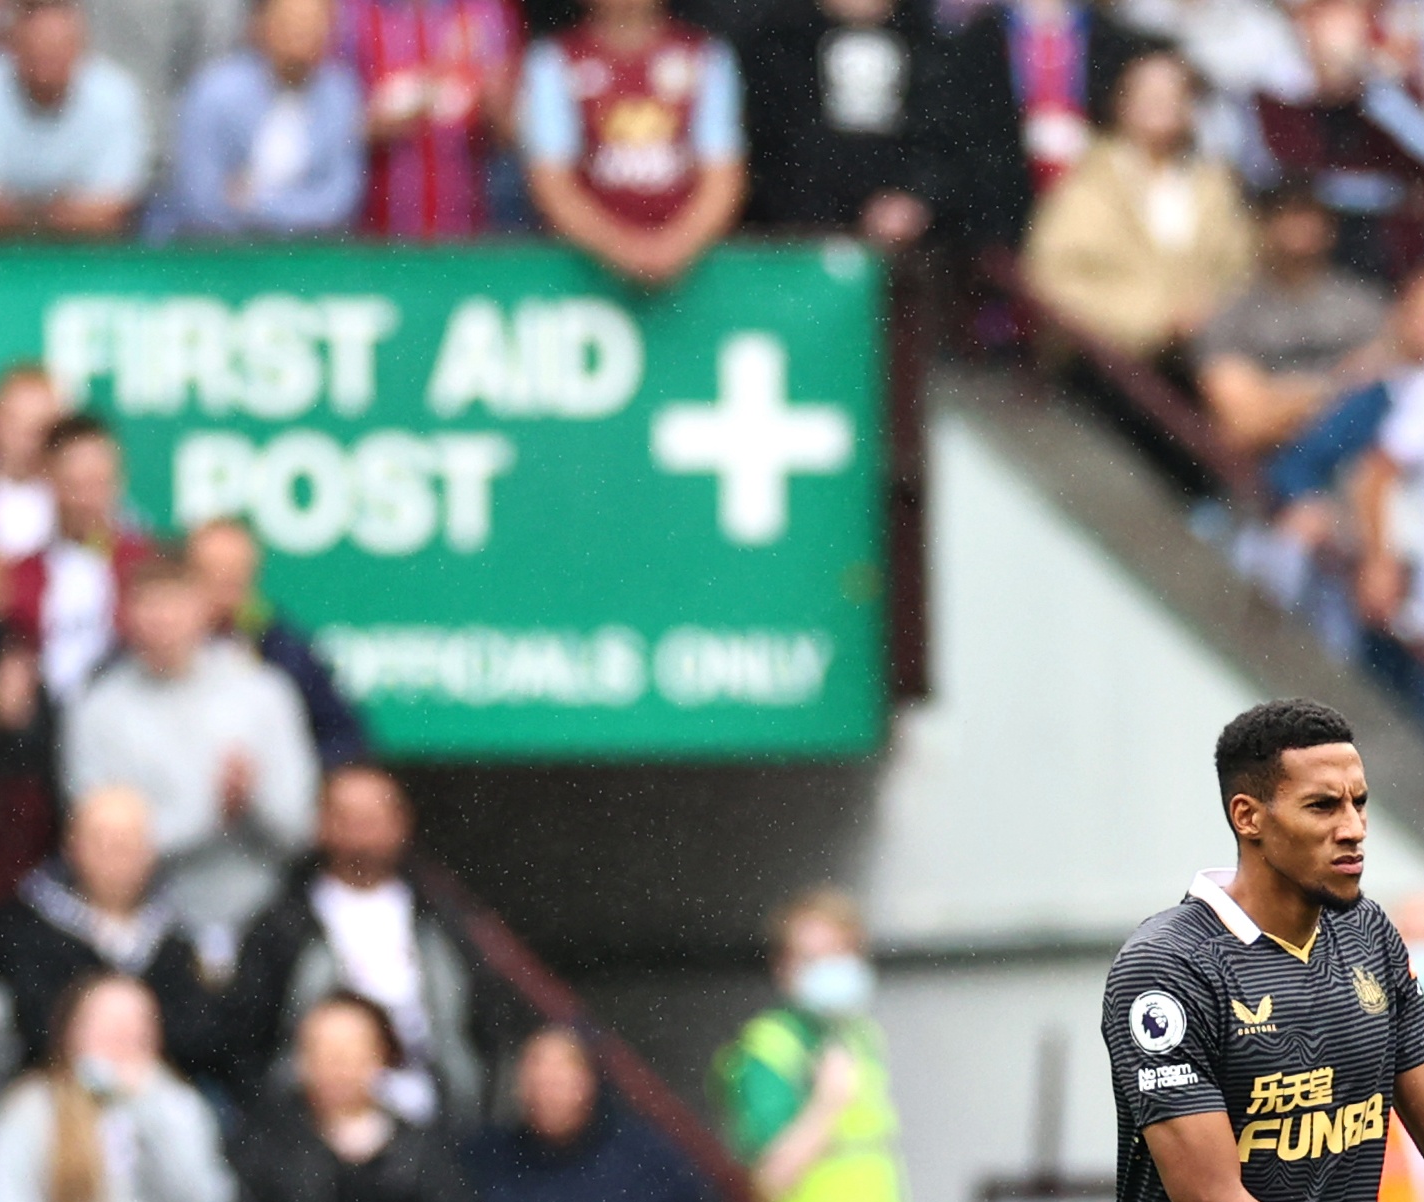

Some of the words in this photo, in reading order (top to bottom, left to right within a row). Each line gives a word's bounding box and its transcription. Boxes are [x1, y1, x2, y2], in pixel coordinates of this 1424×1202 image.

[43, 296, 397, 418] FIRST
[425, 296, 644, 420] AID
[175, 430, 515, 555] POST
[655, 624, 832, 705] ONLY
[1138, 1068, 1156, 1080] No
[1156, 1063, 1191, 1077] room
[1139, 1079, 1156, 1092] for
[1157, 1072, 1199, 1088] racism
[1246, 1066, 1334, 1115] 乐天堂
[1239, 1093, 1384, 1163] FUN88
